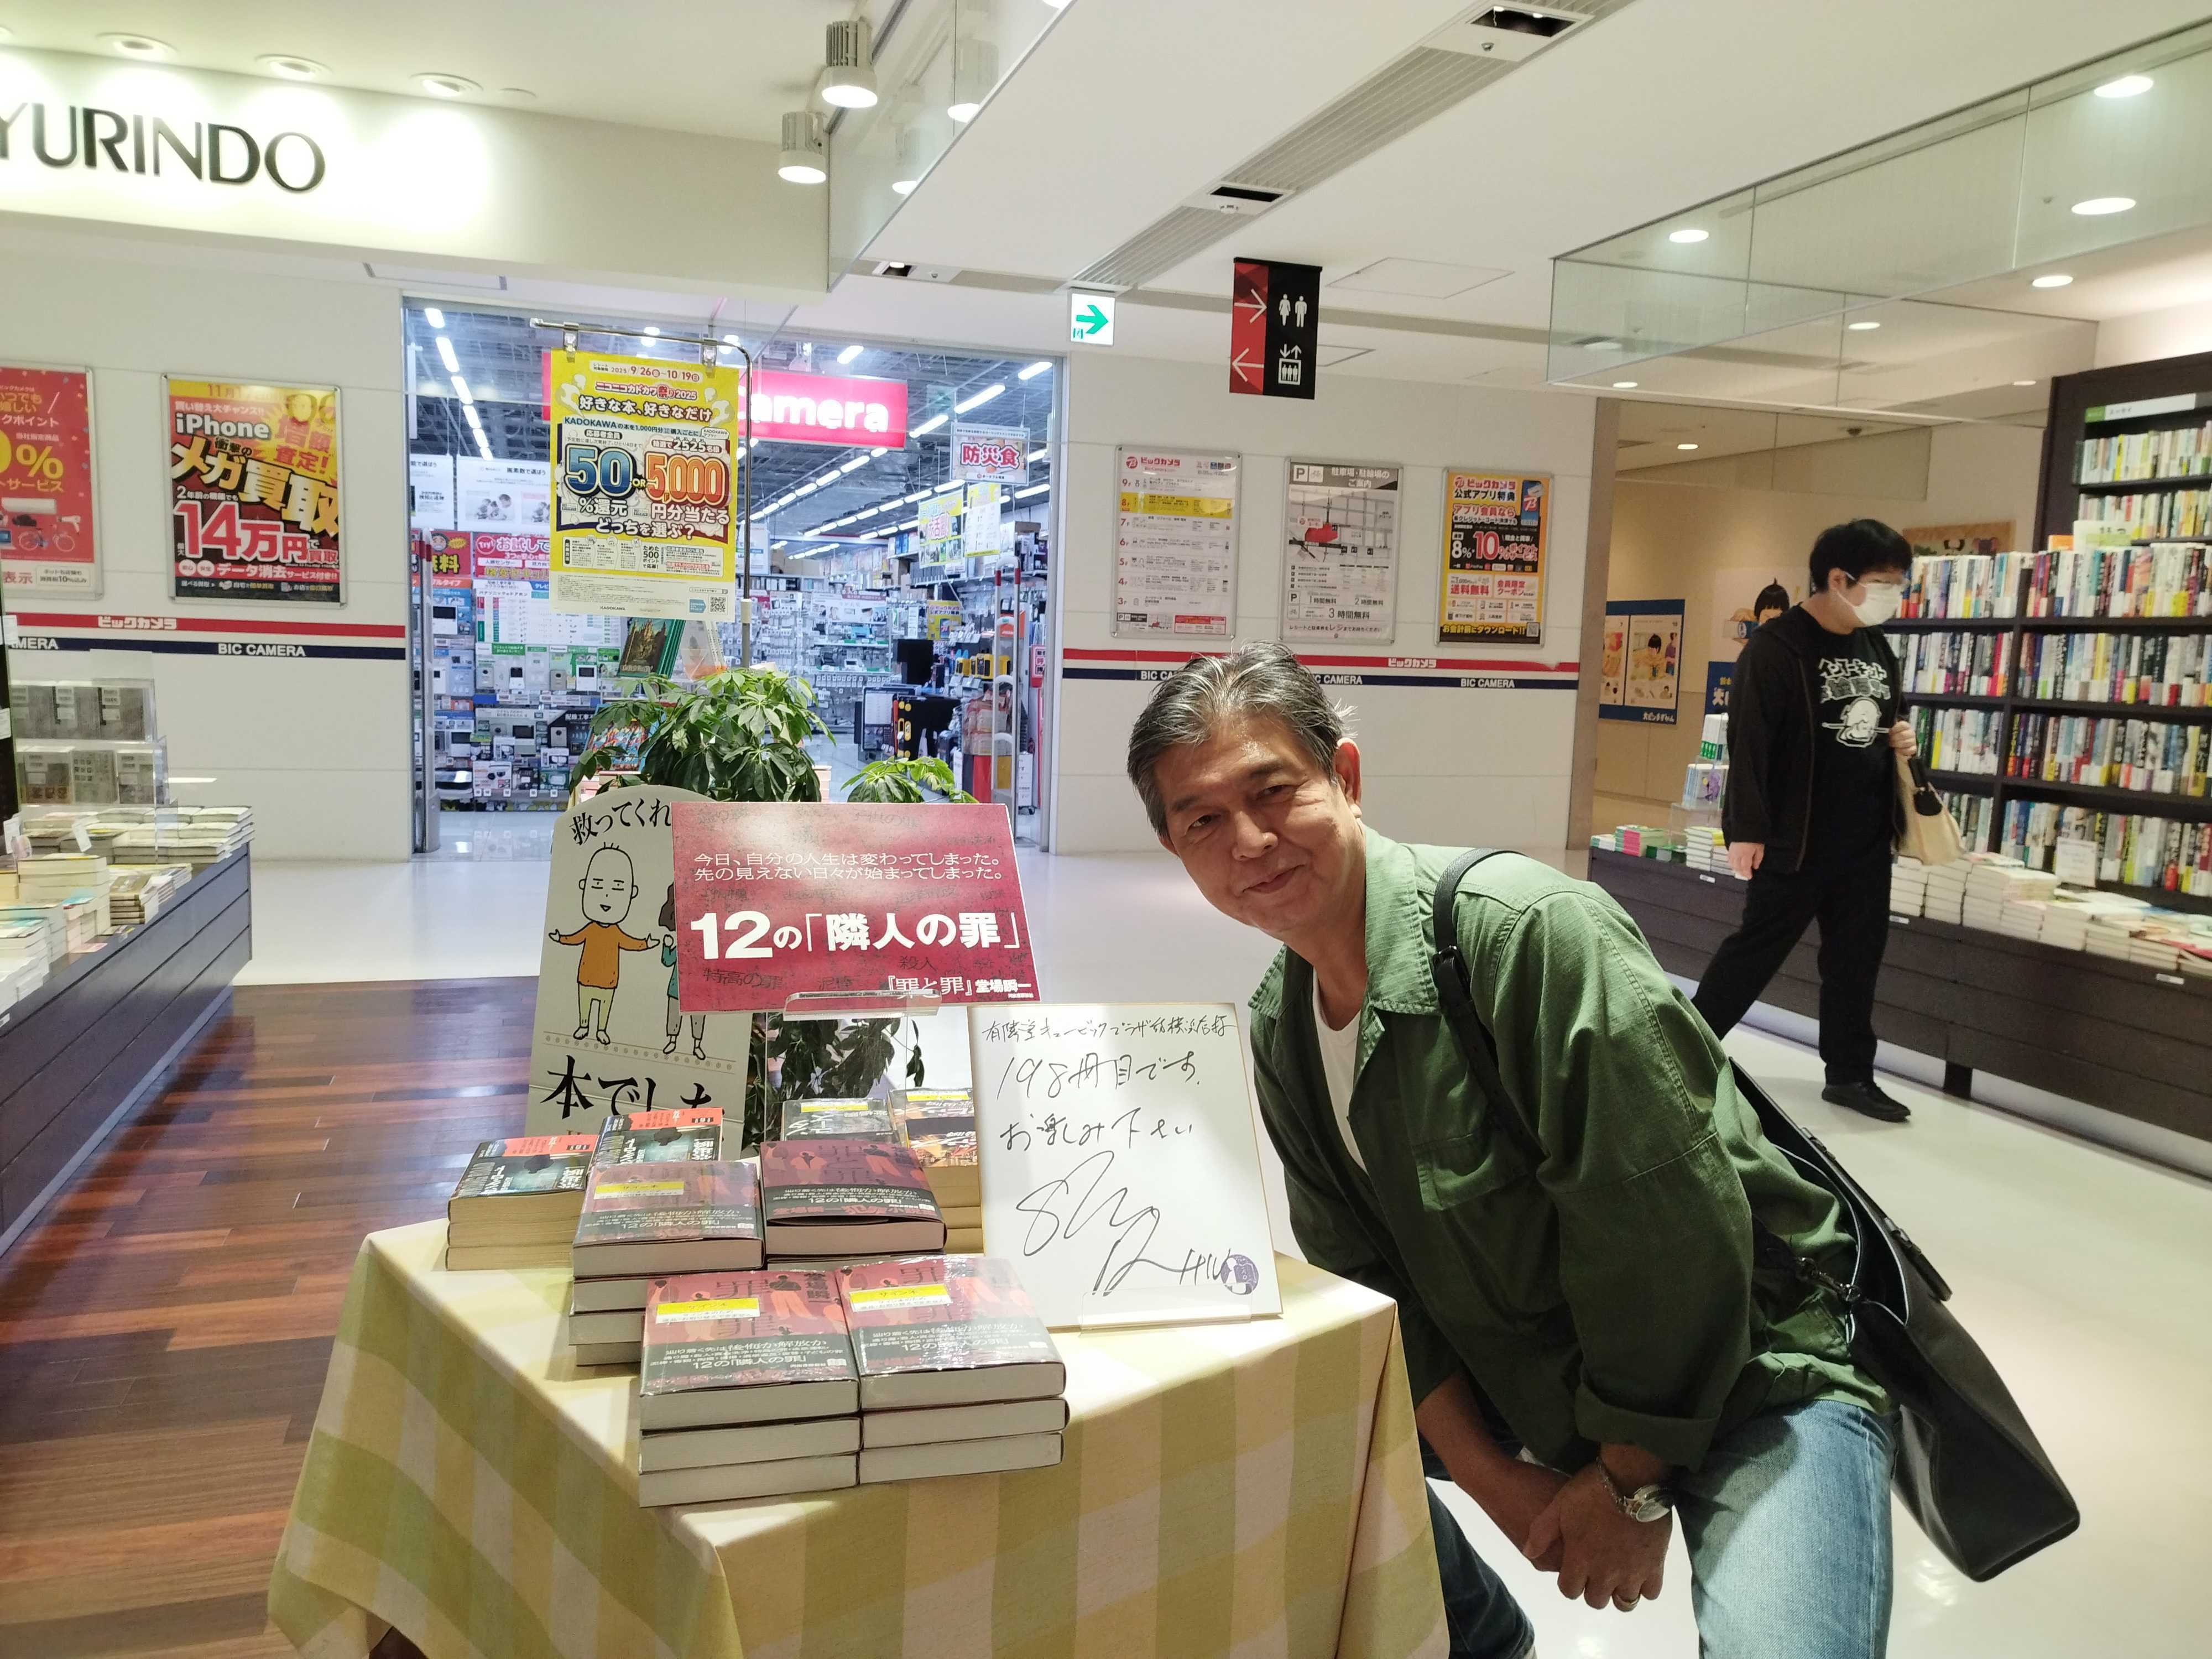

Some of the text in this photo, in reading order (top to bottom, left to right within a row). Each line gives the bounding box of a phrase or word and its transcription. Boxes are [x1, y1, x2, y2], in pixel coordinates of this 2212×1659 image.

[0, 102, 326, 194] YURINDO
[578, 395, 712, 422] 好きな本、好きなだけ
[175, 413, 271, 440] iPhone
[961, 442, 1020, 468] 防災食
[1140, 456, 1181, 467] ビックカメラ
[565, 445, 634, 495] 50
[632, 478, 646, 488] OR
[1296, 467, 1306, 479] P
[170, 435, 339, 538] メガ買取
[1467, 478, 1516, 489] ビックカメラ
[1454, 489, 1516, 502] 公式アプリ特典
[578, 498, 731, 525] %還元 円分当たる
[1453, 504, 1516, 517] アプリ会員なら
[643, 551, 659, 560] 500
[1450, 580, 1526, 596] 送料無料 会員限定
[1290, 593, 1298, 602] P
[1328, 607, 1370, 620] 3時間無料
[98, 615, 177, 630] ビックカメラ
[8, 637, 59, 651] AMERA
[218, 643, 306, 657] BIC CAMERA
[1387, 656, 1437, 670] ビックカメラ
[1140, 670, 1158, 681] BIC
[1323, 674, 1363, 686] CAMERA
[1460, 677, 1515, 690] BIC CAMERA
[568, 797, 671, 846] 救ってくれ
[694, 852, 1000, 867] 今日、自分の人生は変わってしまった。
[694, 867, 1002, 881] 先の見えない日々が始まってしまった。
[690, 910, 1020, 960] 12の「隣人の罪」
[899, 955, 937, 972] 殺人
[888, 975, 1032, 999] 『罪と罪』 堂場瞬一
